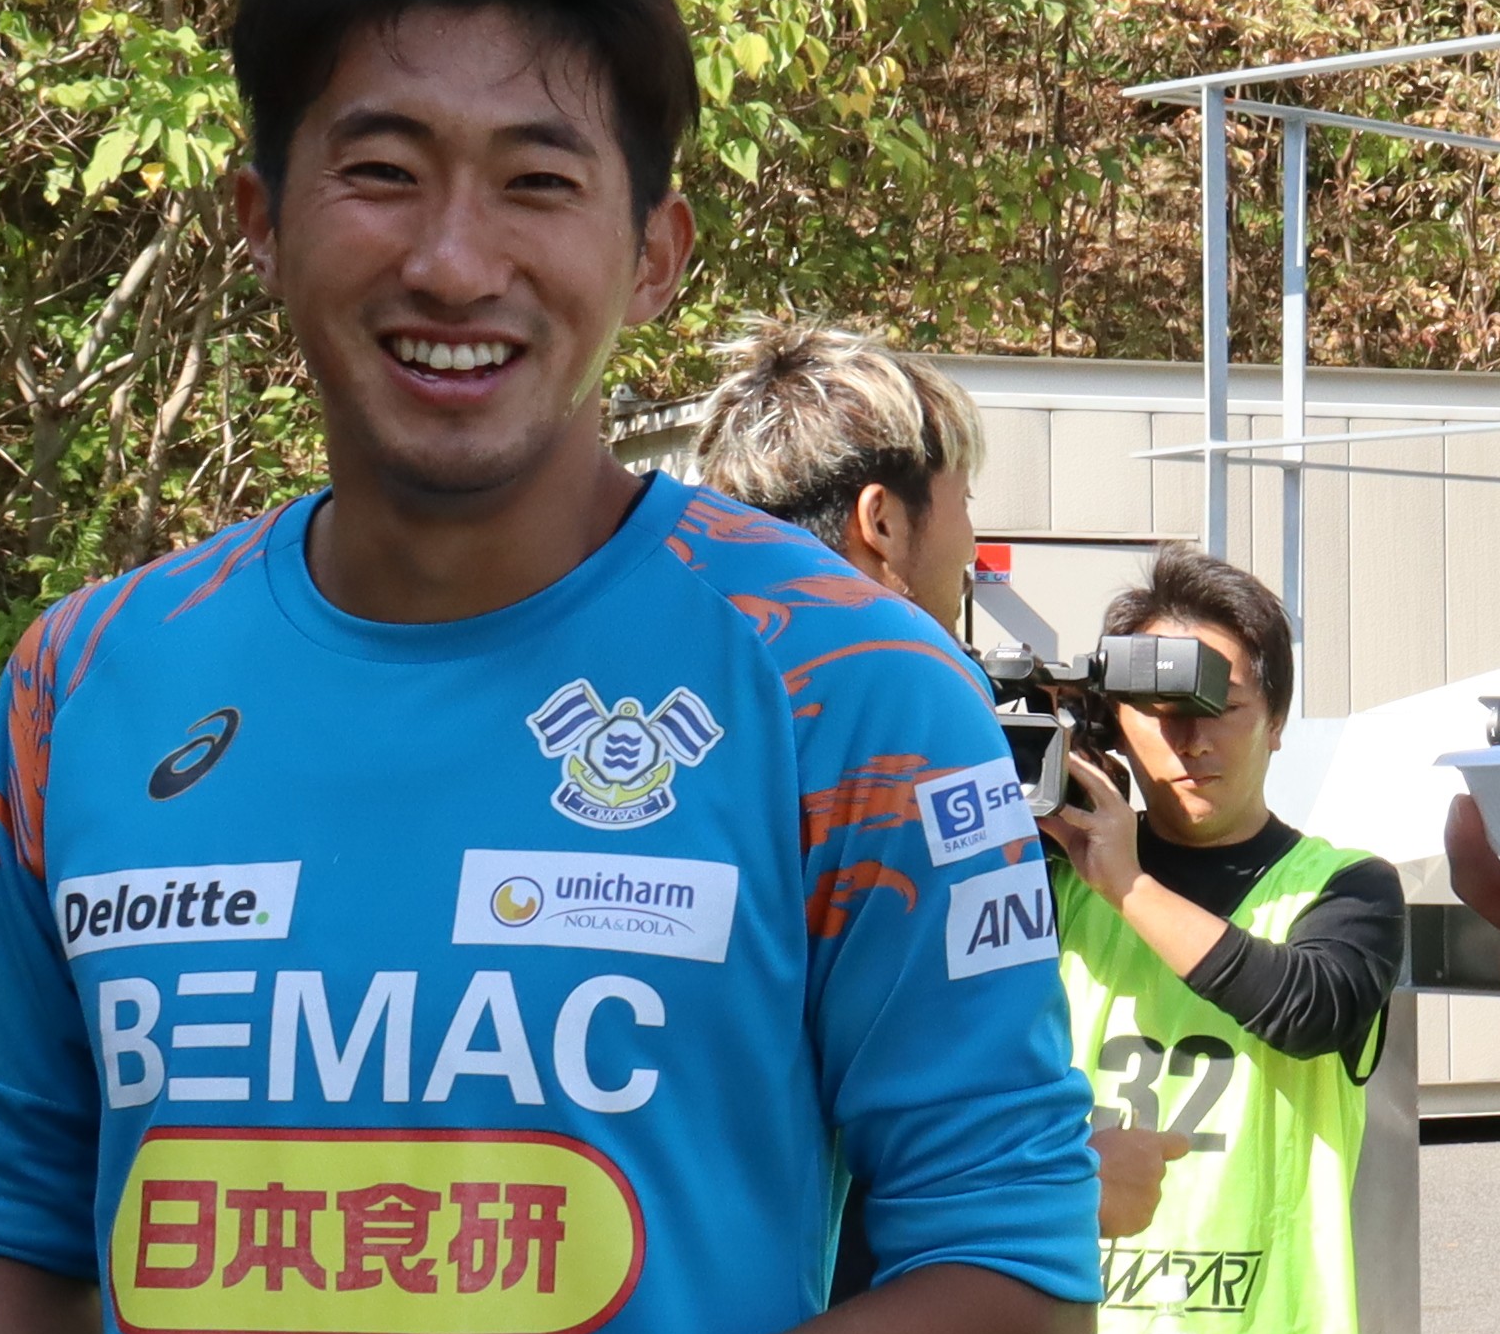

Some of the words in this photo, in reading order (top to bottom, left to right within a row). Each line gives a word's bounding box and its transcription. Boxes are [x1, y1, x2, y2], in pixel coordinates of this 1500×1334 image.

[944, 830, 987, 854] SAKURAI
[65, 880, 270, 944] Deloitte.
[555, 871, 695, 910] unicharm
[563, 913, 675, 937] NOLA&DOLA
[99, 969, 667, 1114] BEMAC
[1089, 1034, 1236, 1153] 32
[133, 1179, 568, 1294] 日本食研
